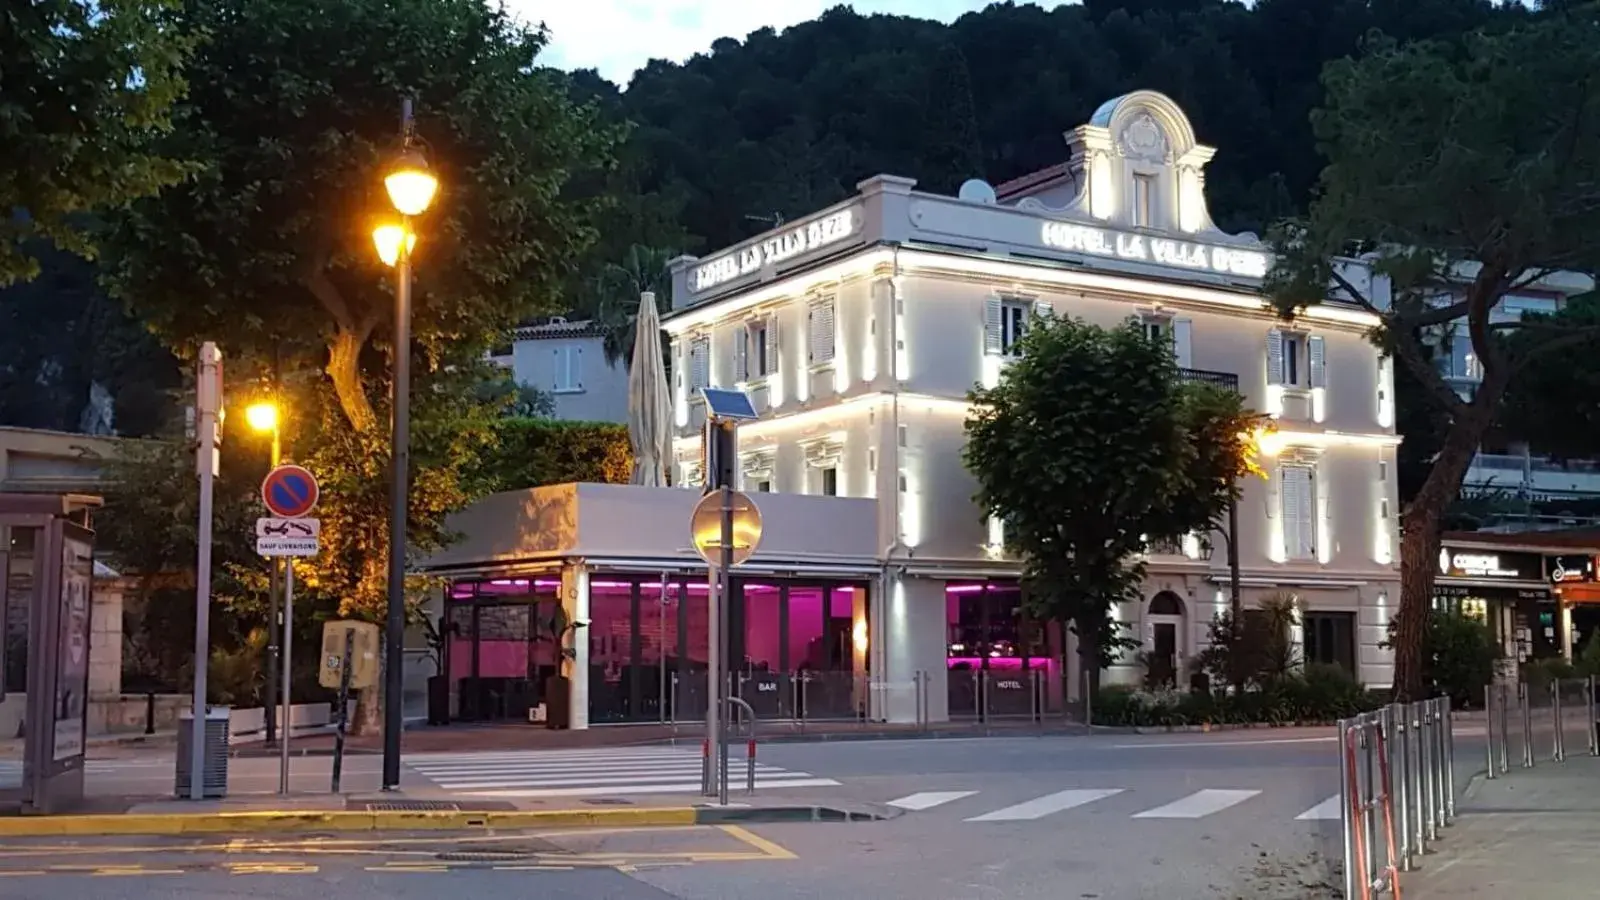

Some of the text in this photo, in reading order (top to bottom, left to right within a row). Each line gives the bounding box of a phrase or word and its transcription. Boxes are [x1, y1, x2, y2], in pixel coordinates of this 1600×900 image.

[1042, 221, 1114, 254] HOTEL
[1117, 233, 1147, 260] LA
[1151, 239, 1208, 268] VILLA
[758, 683, 777, 691] BAR
[997, 681, 1021, 689] HOTEL
